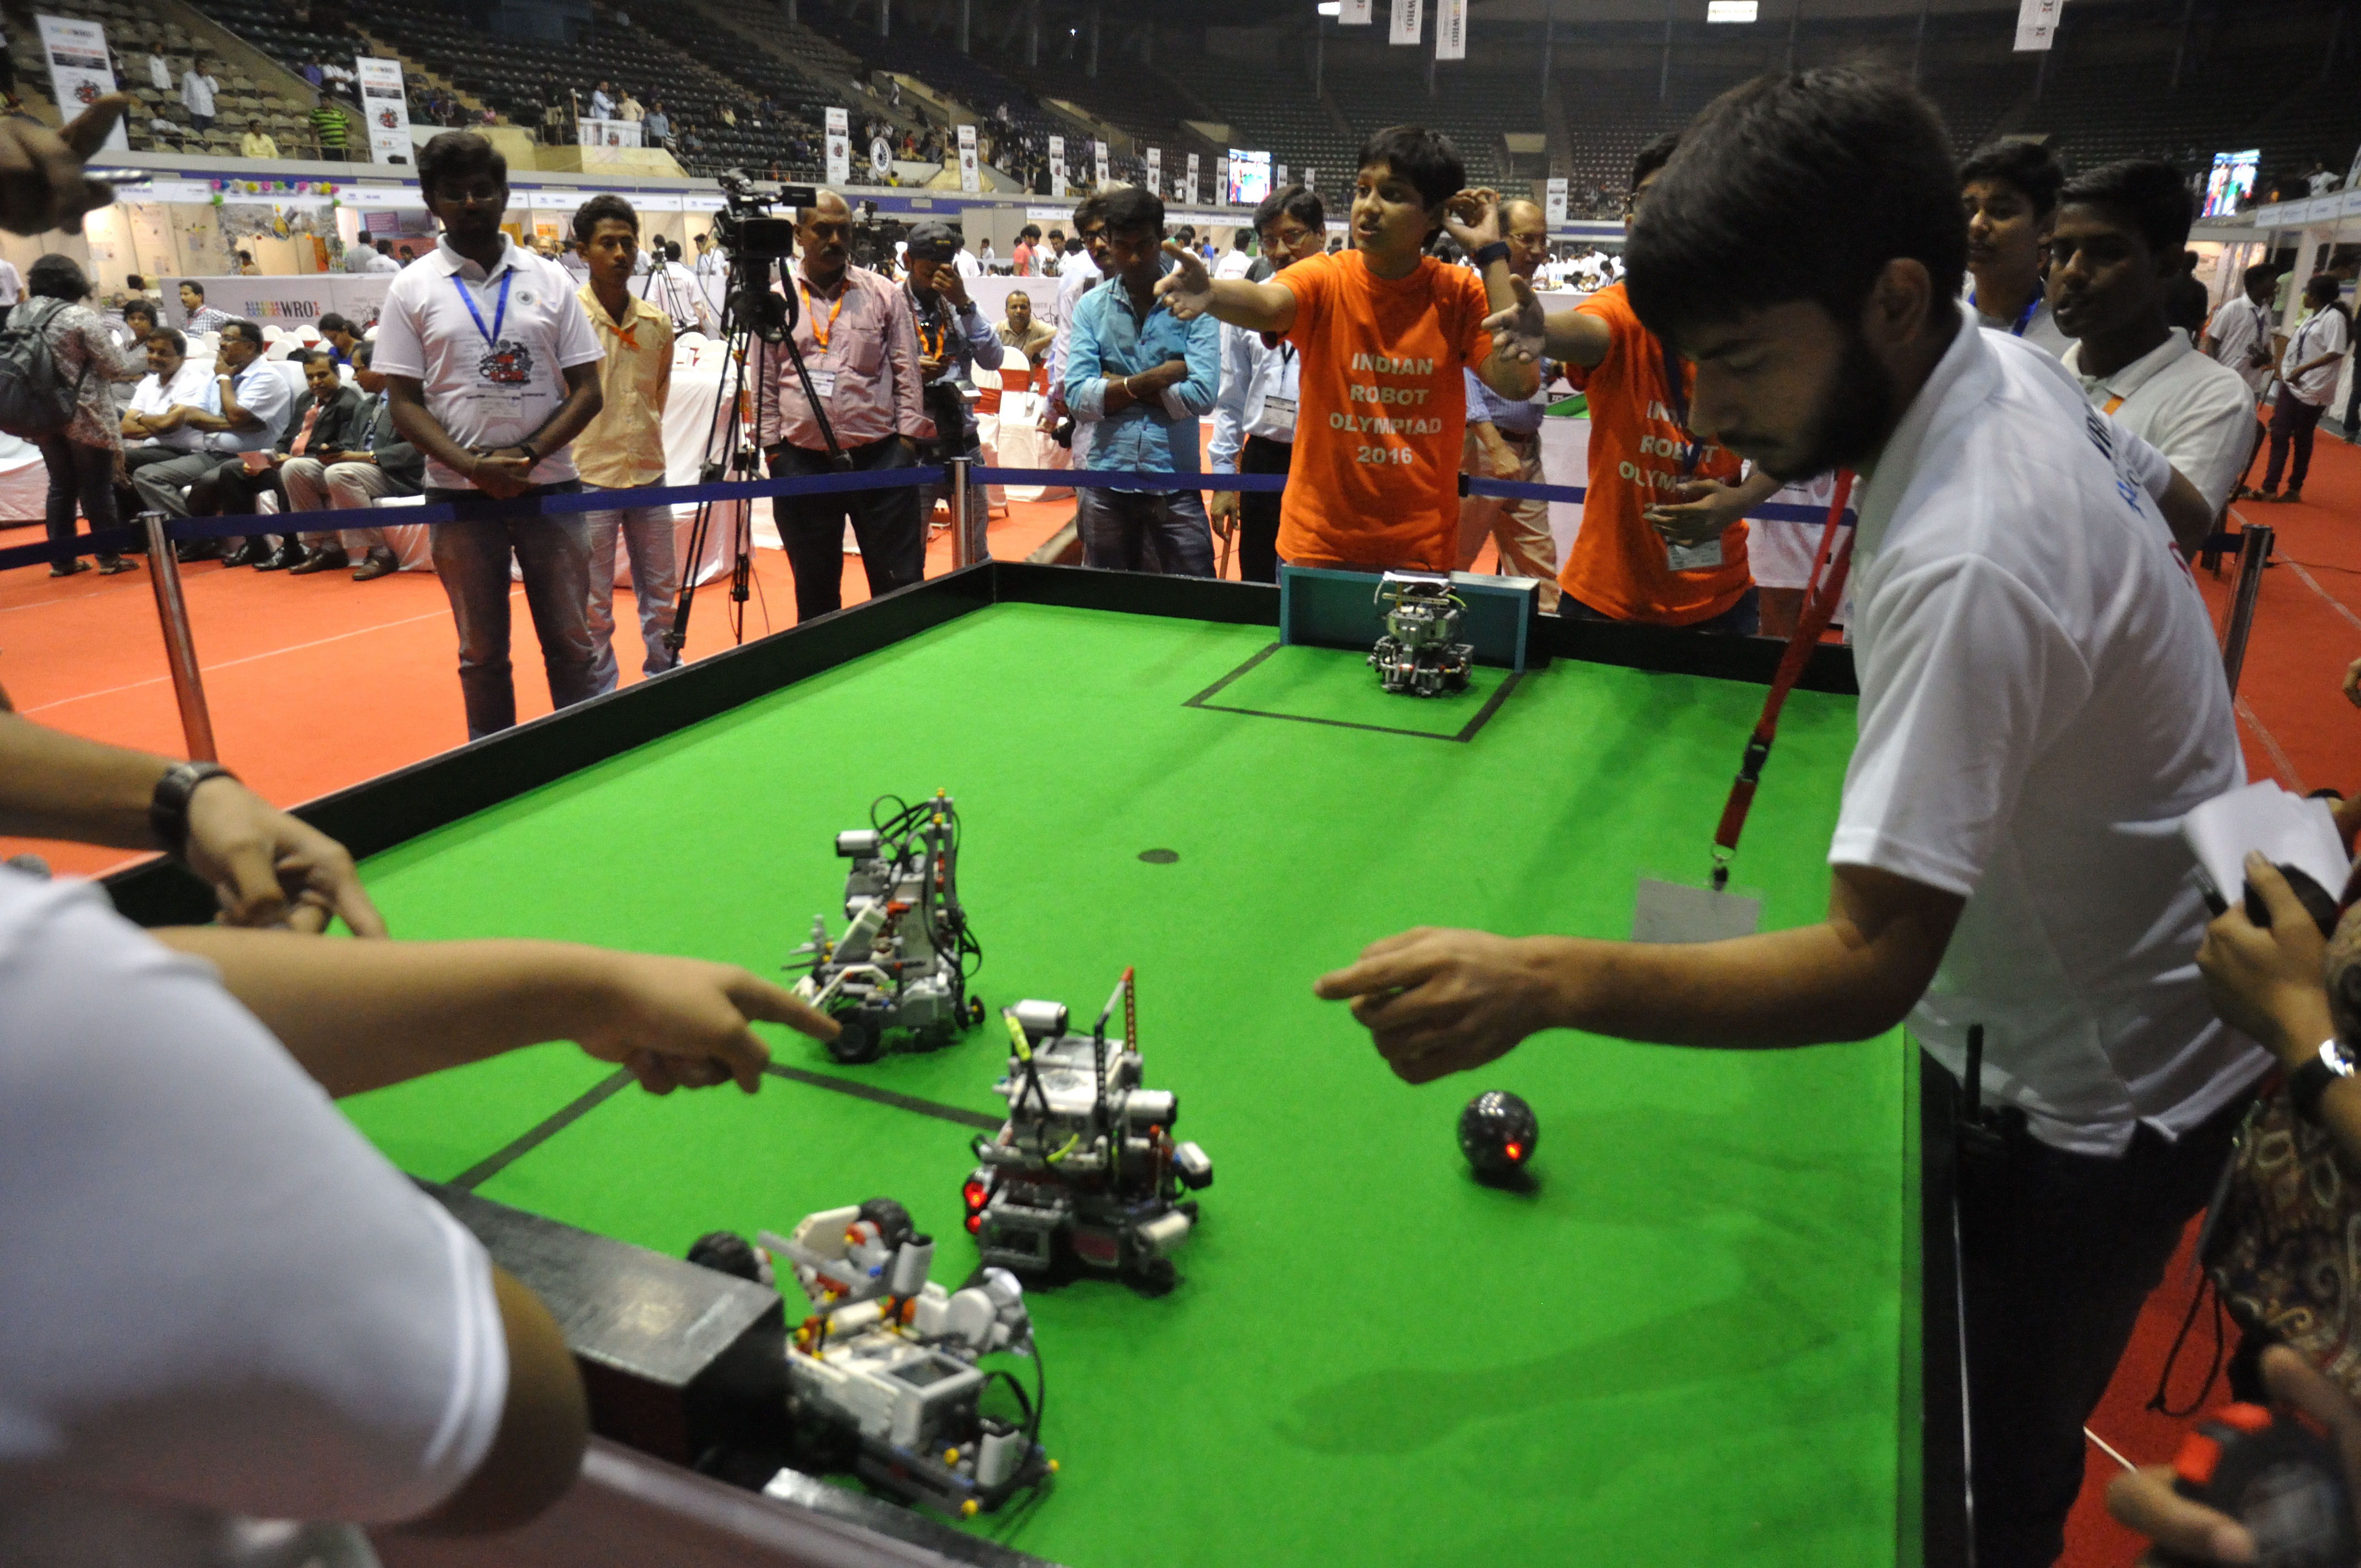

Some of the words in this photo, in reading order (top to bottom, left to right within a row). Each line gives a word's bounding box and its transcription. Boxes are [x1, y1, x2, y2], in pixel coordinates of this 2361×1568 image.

[280, 301, 313, 318] WRO
[1352, 352, 1433, 375] INDIAN
[1350, 384, 1429, 405] ROBOT
[1329, 412, 1442, 434] OLYMPIAD
[1356, 445, 1413, 465] 2016
